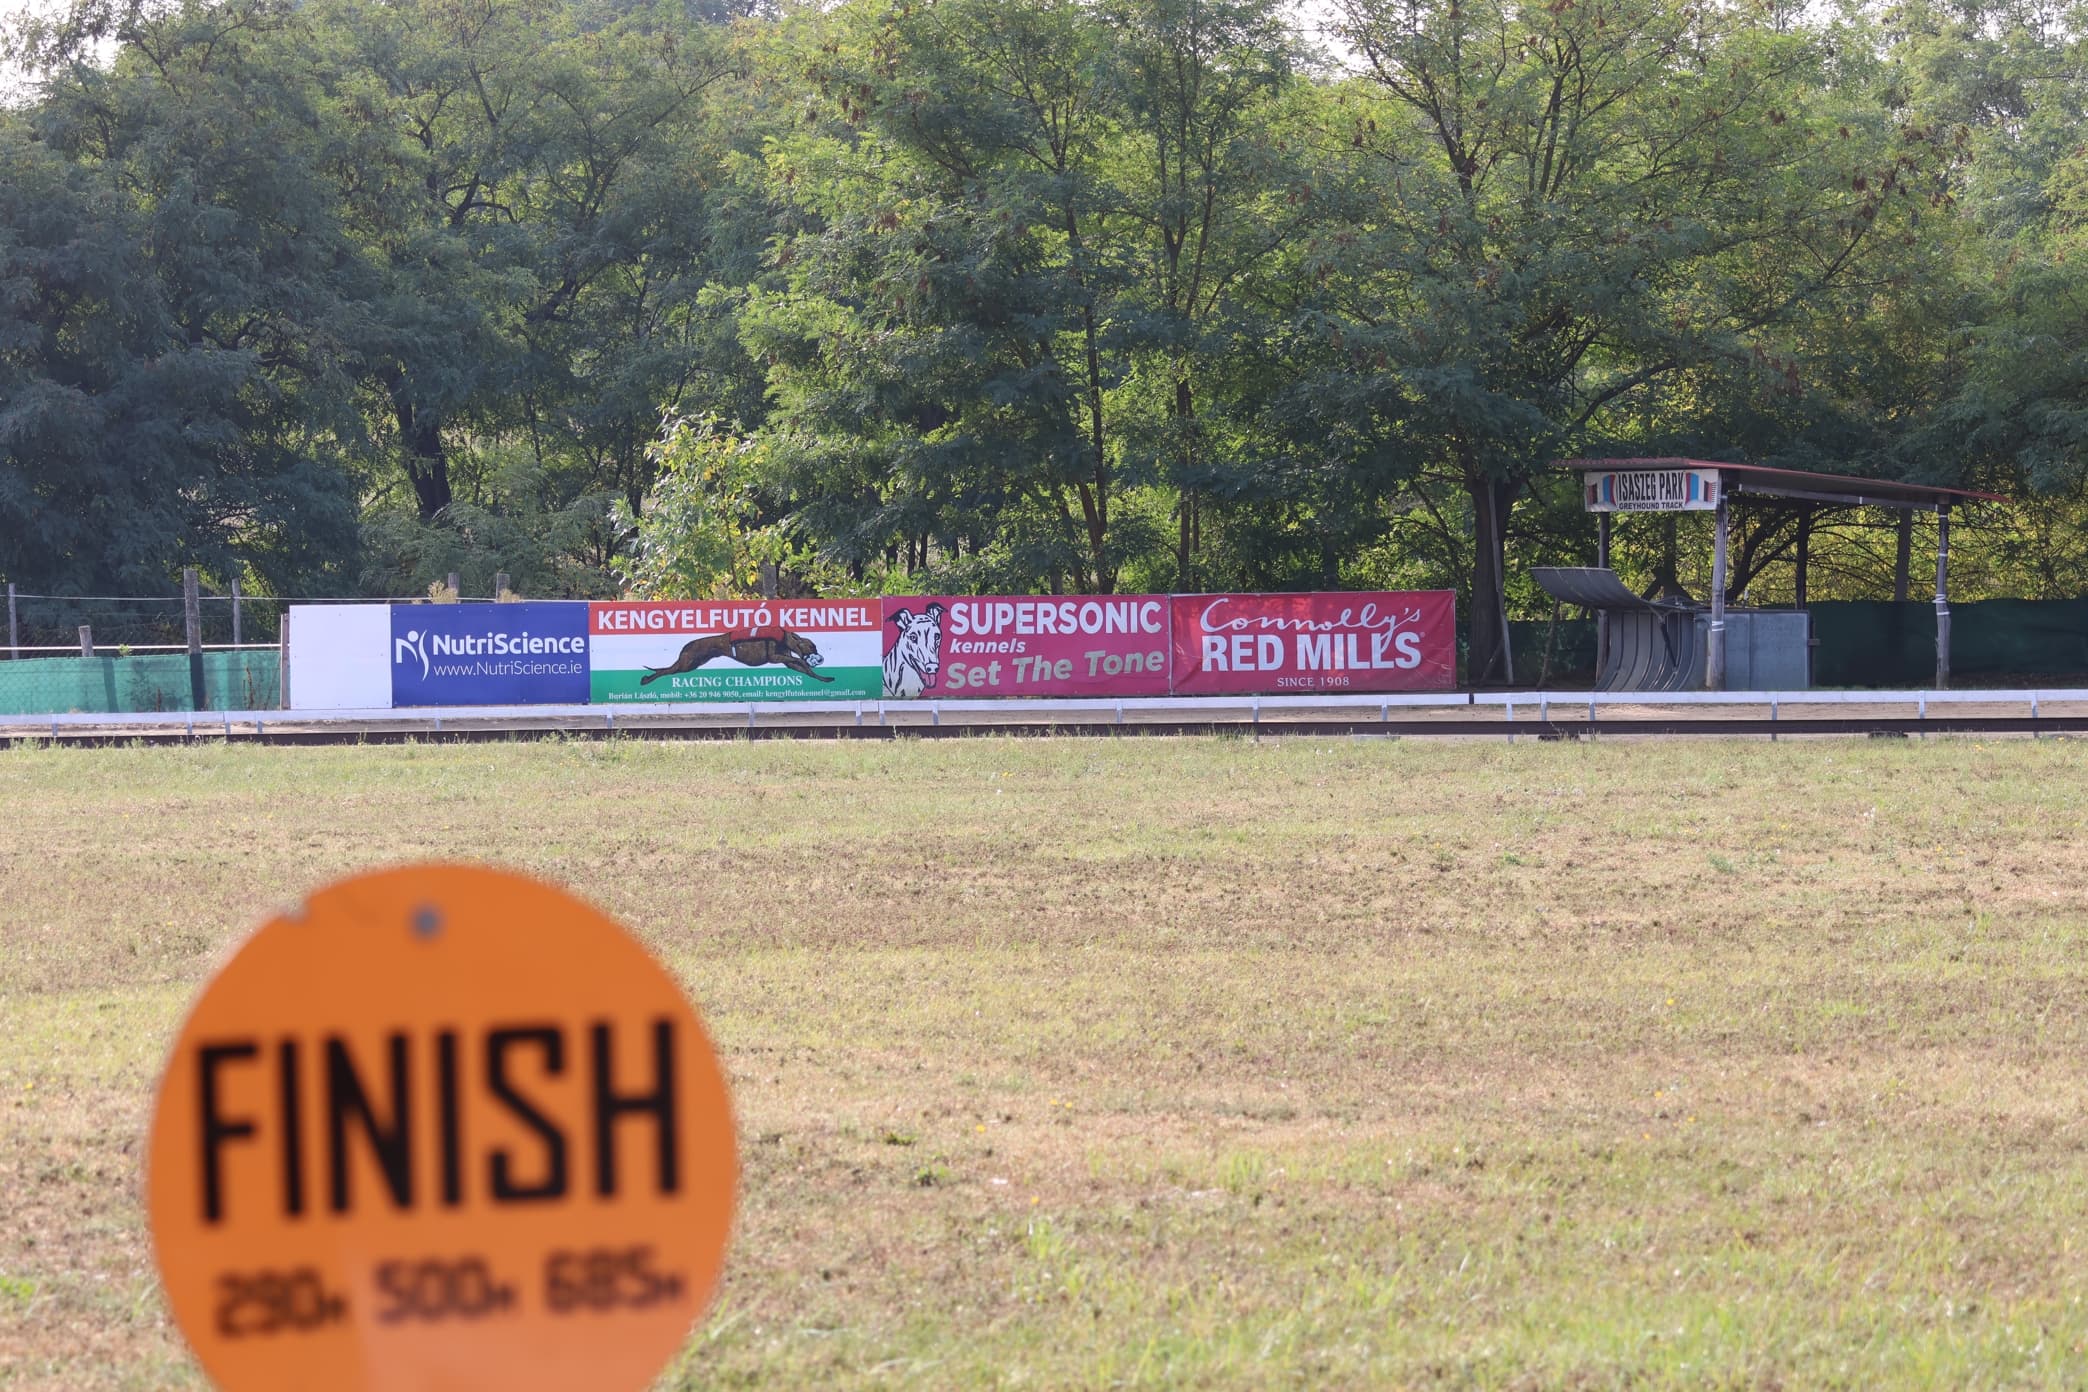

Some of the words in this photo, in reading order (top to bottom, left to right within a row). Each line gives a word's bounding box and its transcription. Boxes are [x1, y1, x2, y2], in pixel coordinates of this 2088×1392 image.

[1618, 472, 1656, 501] ISASZEG
[1659, 472, 1684, 500] PARK
[1618, 502, 1660, 510] GREYHOUND
[1661, 501, 1683, 509] TRACK
[598, 602, 772, 630] KENGYELFUTÓ
[779, 607, 873, 628] KENNEL
[949, 600, 1162, 636] SUPERSONIC
[1200, 597, 1421, 655] Connolly's
[432, 631, 585, 656] NutriScience
[949, 637, 1026, 655] kennels
[1201, 634, 1284, 672] RED
[1296, 631, 1422, 671] MILLS
[433, 660, 583, 676] www.NutriScience.ie
[671, 676, 722, 688] RACING
[725, 675, 803, 687] CHAMPIONS
[945, 660, 1002, 689] Set
[1012, 654, 1073, 684] The
[1084, 649, 1165, 677] Tone
[1276, 677, 1314, 687] SINCE
[1320, 676, 1350, 687] 1908
[194, 1014, 682, 1226] FINISH
